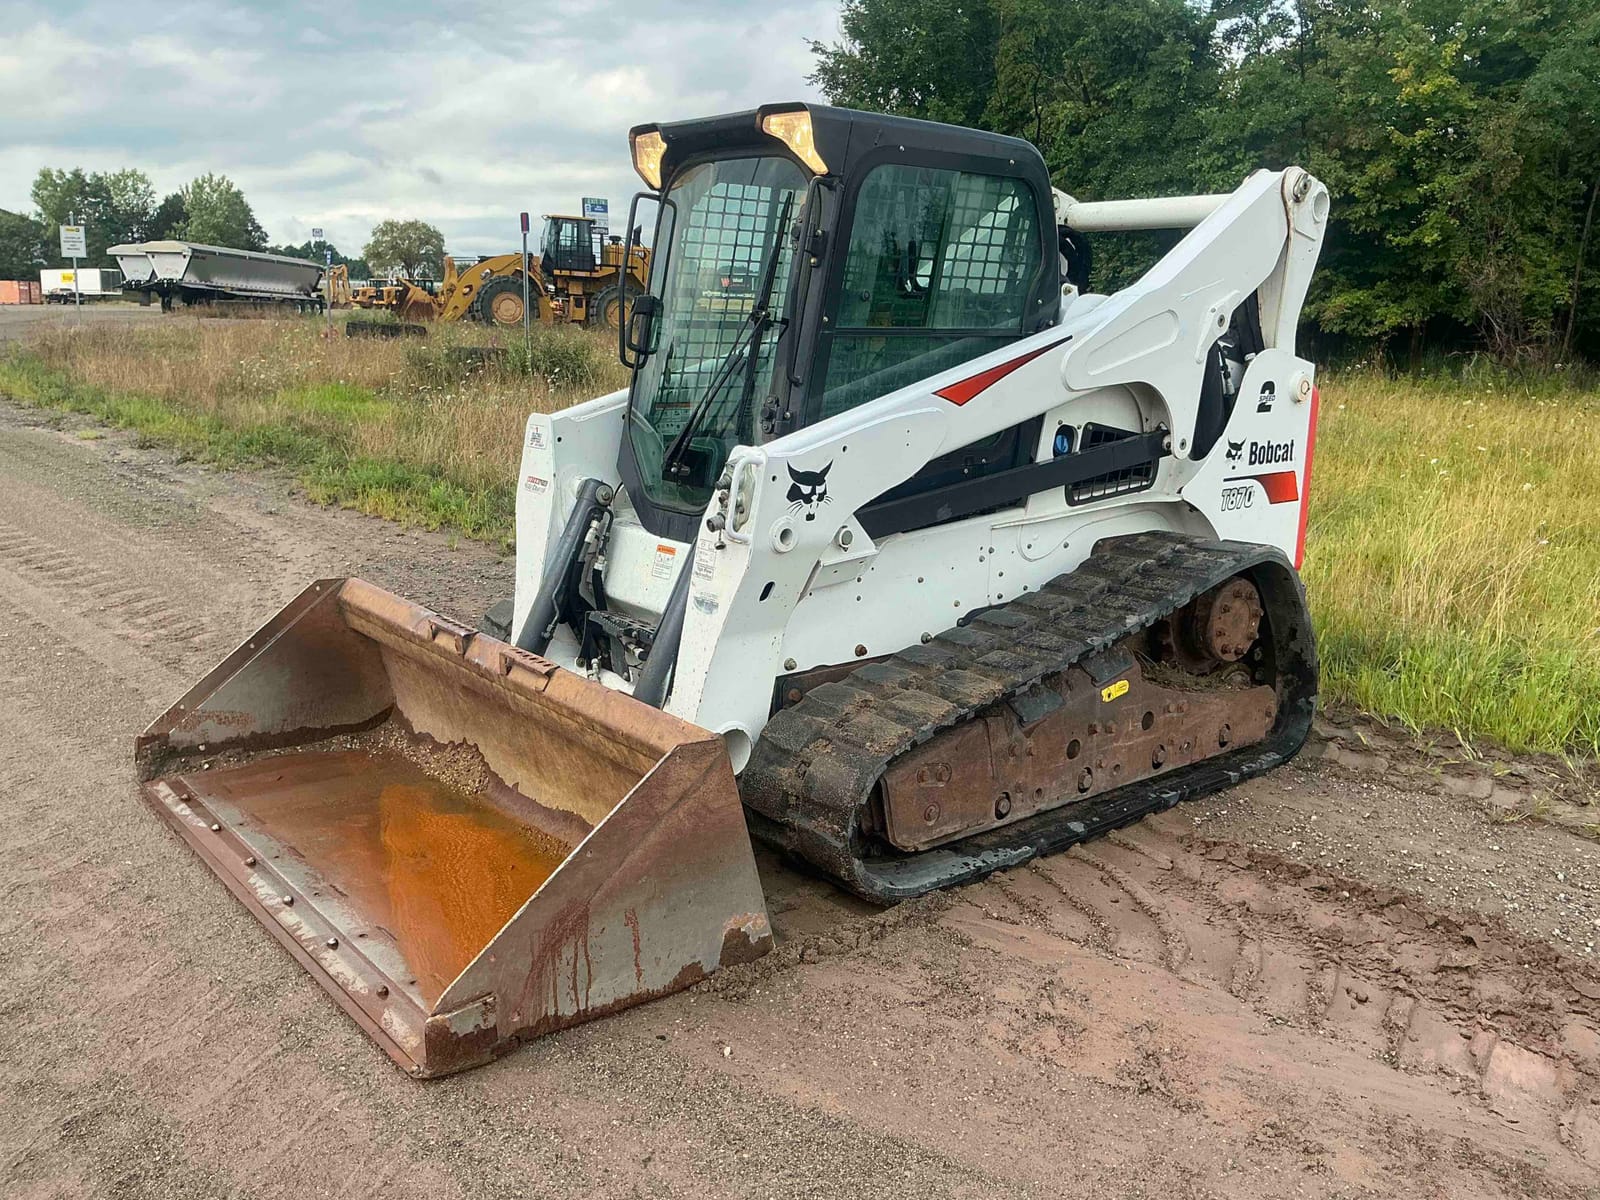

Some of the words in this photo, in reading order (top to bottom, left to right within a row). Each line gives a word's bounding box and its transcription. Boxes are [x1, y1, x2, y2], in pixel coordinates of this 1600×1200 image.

[1256, 380, 1276, 413] 2
[1259, 394, 1276, 402] SPEED
[1248, 439, 1295, 466] Bobcat
[1221, 485, 1256, 512] T870
